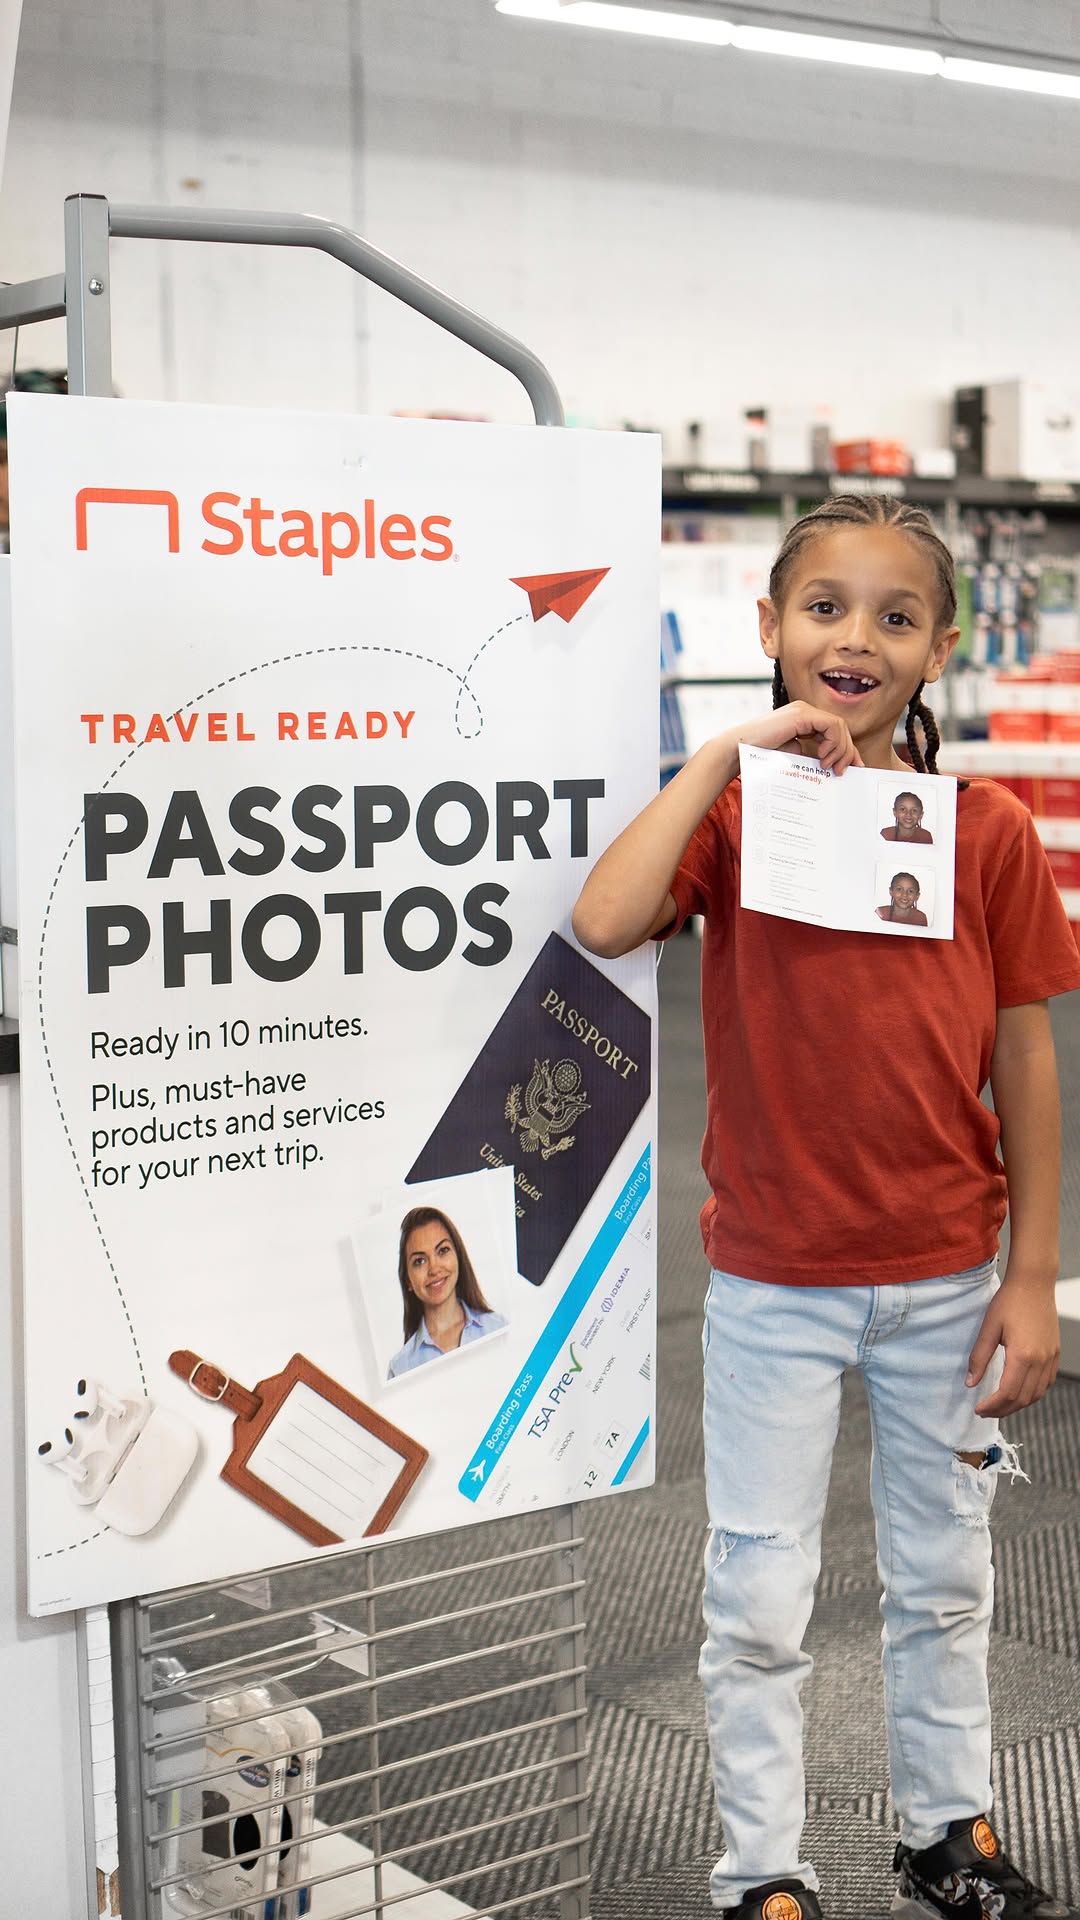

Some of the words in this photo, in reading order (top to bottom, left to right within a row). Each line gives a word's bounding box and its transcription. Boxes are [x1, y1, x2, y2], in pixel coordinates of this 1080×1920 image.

[201, 491, 453, 576] Staples
[81, 712, 256, 744] TRAVEL
[277, 710, 416, 741] READY
[801, 765, 815, 774] can
[815, 767, 831, 779] help
[83, 778, 606, 882] PASSPORT
[85, 881, 514, 995] PHOTOS
[91, 1026, 180, 1061] Ready
[187, 1024, 211, 1051] in
[218, 1019, 250, 1048] 10
[258, 1014, 369, 1045] minutes.
[541, 988, 639, 1081] PASSPORT
[91, 1082, 157, 1112] Plus,
[165, 1070, 307, 1105] must-have
[91, 1116, 218, 1158] products
[225, 1104, 275, 1136] and
[282, 1097, 386, 1129] services
[91, 1160, 131, 1188] for
[138, 1156, 200, 1190] your
[208, 1144, 267, 1175] next
[274, 1138, 325, 1170] trip.
[479, 1143, 508, 1169] Unite
[614, 1171, 647, 1221] Boarding
[610, 1266, 631, 1298] IDEMIA
[625, 1311, 640, 1333] FIRST
[592, 1376, 605, 1394] NEW
[602, 1356, 617, 1377] YORK
[485, 1398, 521, 1450] Boarding
[514, 1373, 533, 1399] Pass
[527, 1406, 557, 1438] TSA
[548, 1372, 575, 1405] Pre
[494, 1439, 506, 1455] First
[503, 1423, 515, 1441] Class
[555, 1430, 575, 1462] LONDON
[605, 1431, 620, 1449] 7A
[583, 1470, 599, 1489] 12
